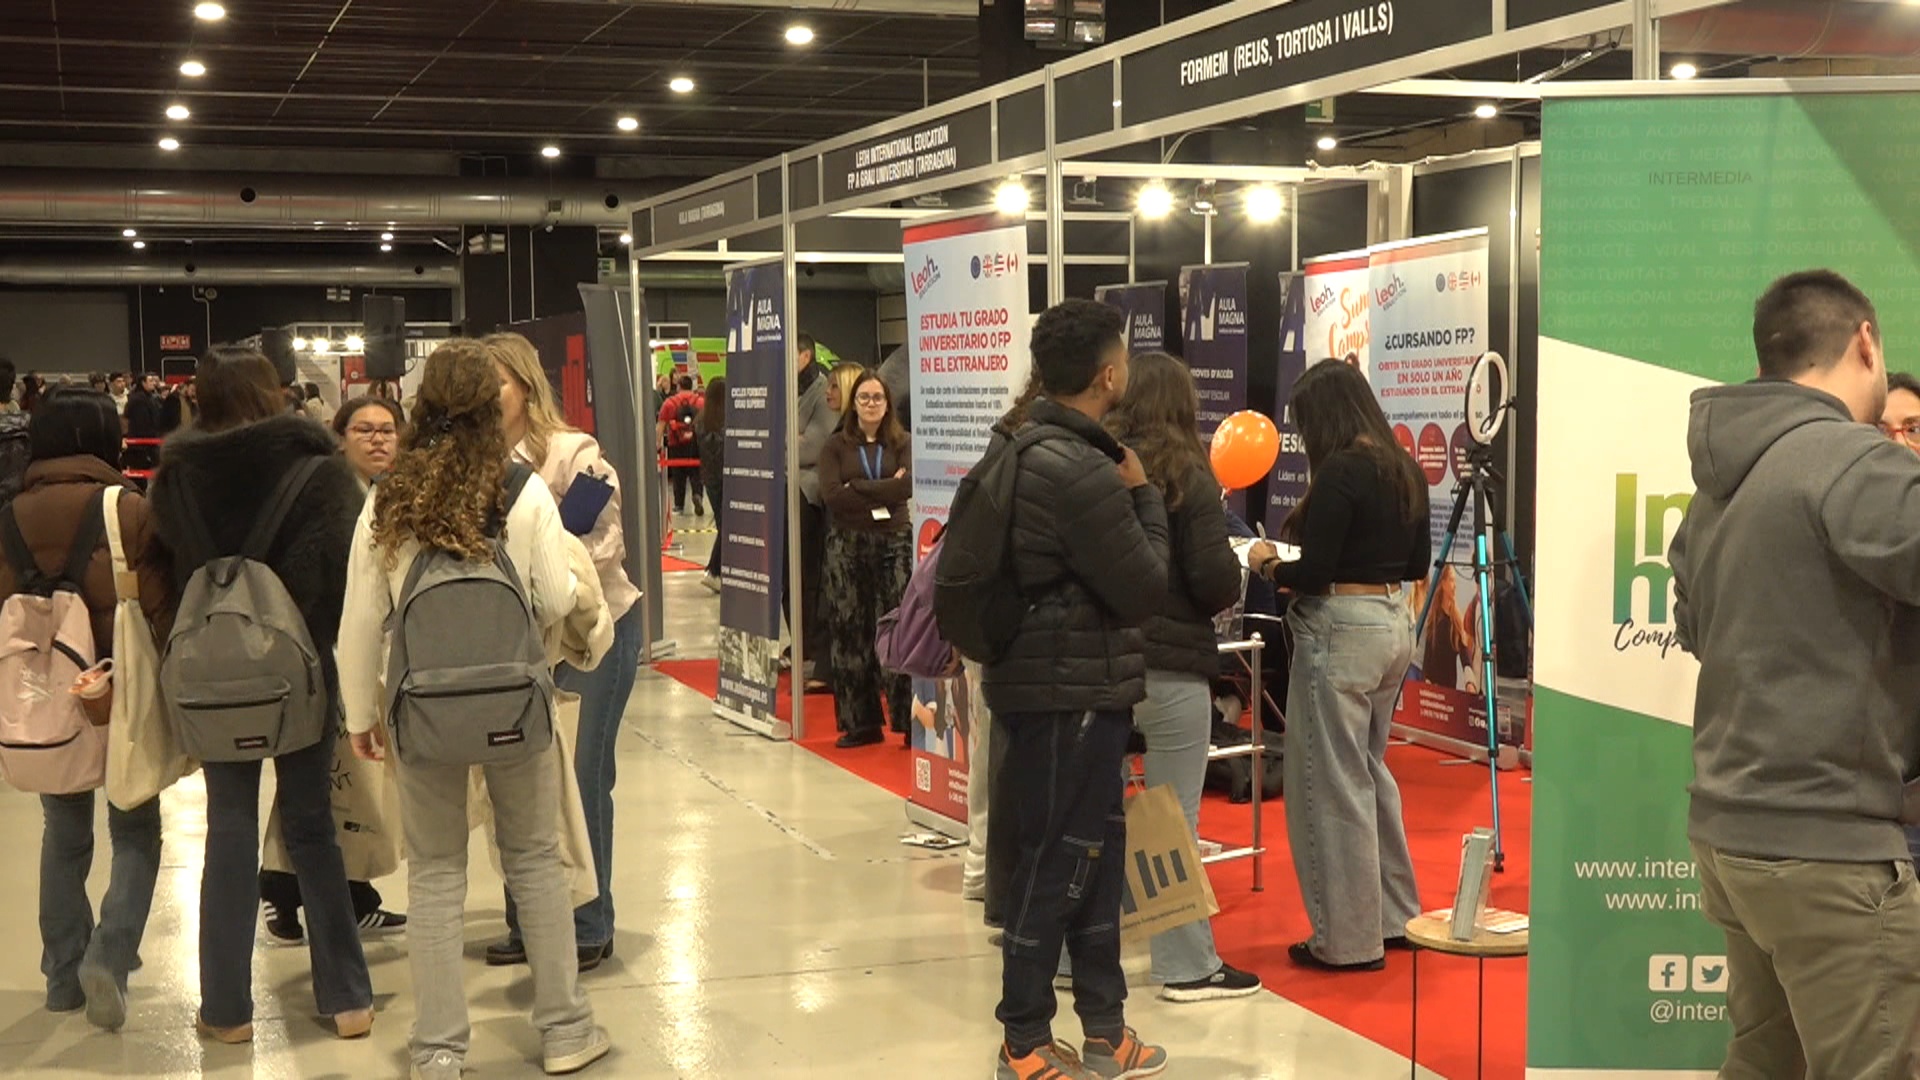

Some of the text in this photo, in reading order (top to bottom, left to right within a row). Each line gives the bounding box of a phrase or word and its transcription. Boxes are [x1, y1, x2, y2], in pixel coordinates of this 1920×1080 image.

[1180, 1, 1393, 86] FORMEM (REUS, TORTOSA I VALLS)
[914, 124, 949, 153] EDUCATION
[915, 146, 957, 179] (TARRAGONA)
[757, 298, 772, 315] AULA
[1219, 298, 1236, 311] AULA
[757, 313, 782, 331] MAGNA
[920, 307, 1009, 331] ESTUDIA TU GRADO
[1135, 313, 1153, 326] AULA
[1218, 311, 1245, 325] MAGNA
[1134, 326, 1161, 339] MAGNA
[1385, 327, 1475, 350] ¿CURSANDO FP?
[919, 331, 1011, 352] UNIVERSITARIO O FP
[920, 355, 1009, 373] EN EL EXTRANJERO
[1401, 360, 1411, 370] TU
[1411, 359, 1432, 369] GRADO
[1397, 368, 1463, 384] EN SOLO UN AÑO
[1421, 387, 1430, 395] EN
[1431, 386, 1439, 395] EL
[1438, 411, 1452, 419] todo
